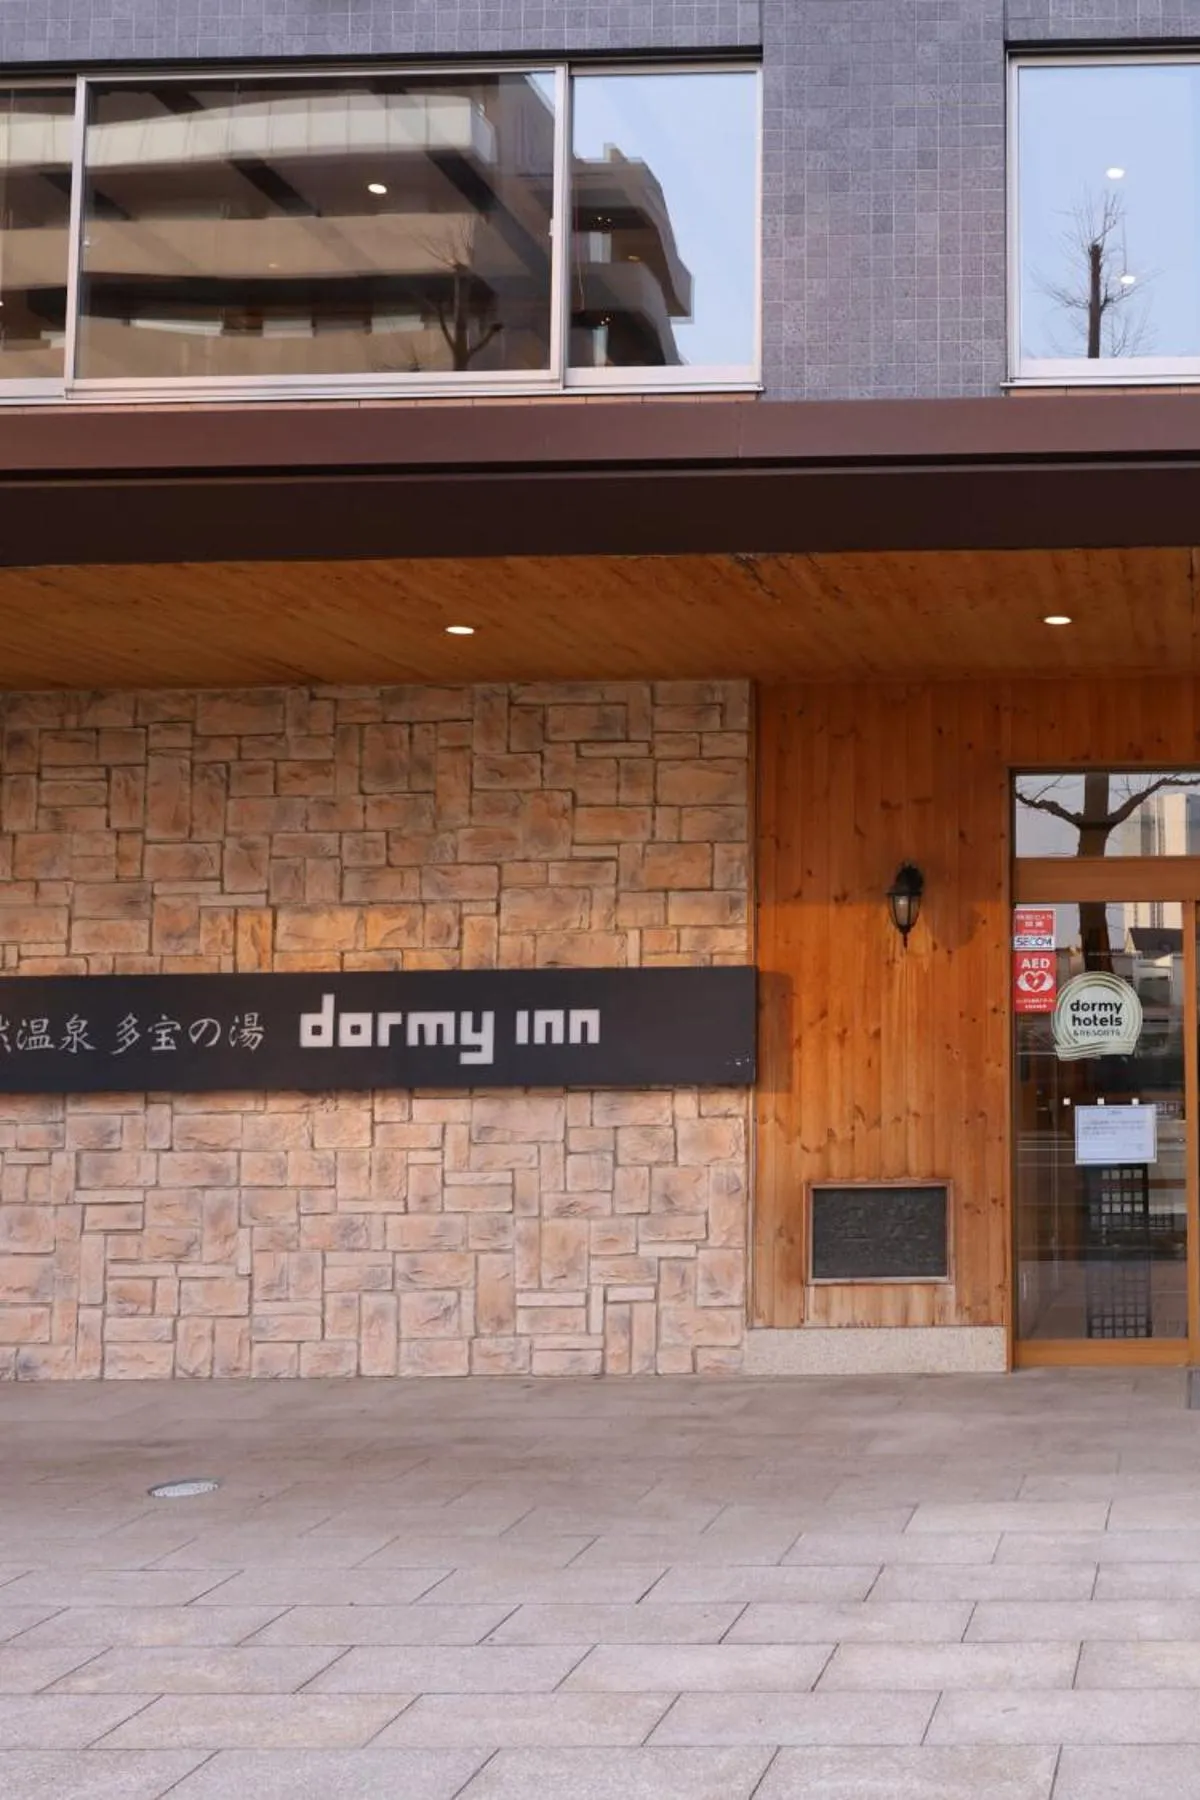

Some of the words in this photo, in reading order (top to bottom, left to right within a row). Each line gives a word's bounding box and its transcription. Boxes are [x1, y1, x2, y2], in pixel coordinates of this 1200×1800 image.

[1021, 957, 1050, 969] AED
[1070, 1000, 1122, 1015] dormy
[1072, 1014, 1122, 1027] hotels
[110, 1011, 265, 1056] 多宝の湯
[300, 993, 495, 1065] dormy
[515, 1008, 600, 1045] inn
